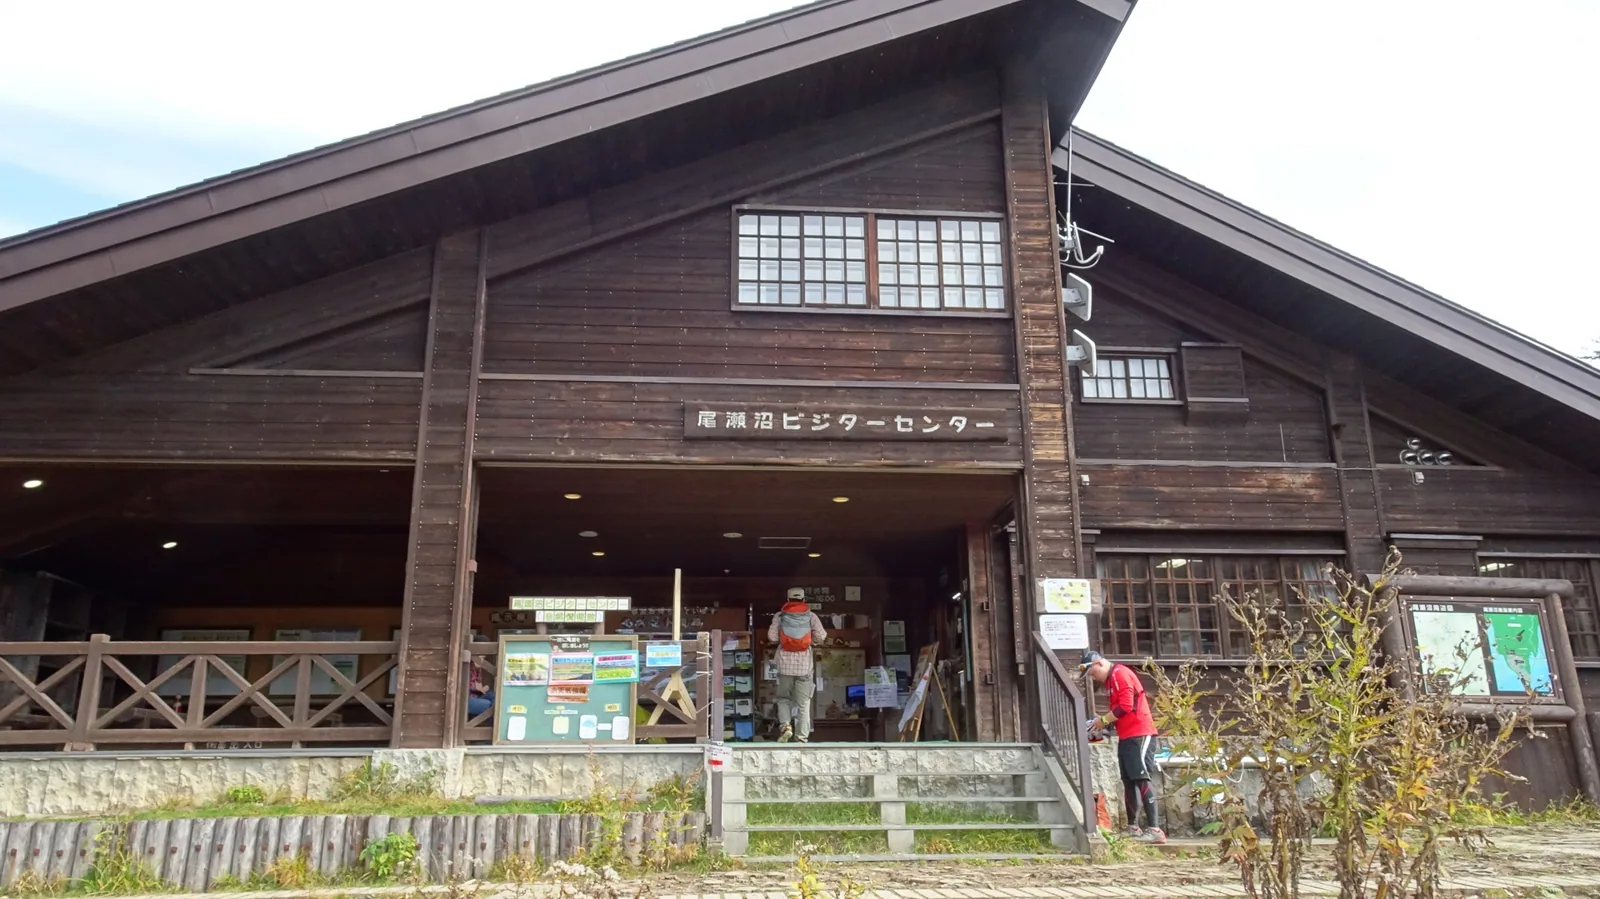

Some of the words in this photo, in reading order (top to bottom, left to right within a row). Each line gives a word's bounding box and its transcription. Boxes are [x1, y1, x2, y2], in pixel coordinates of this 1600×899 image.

[697, 410, 996, 434] 尾瀬沼ビジターセンター
